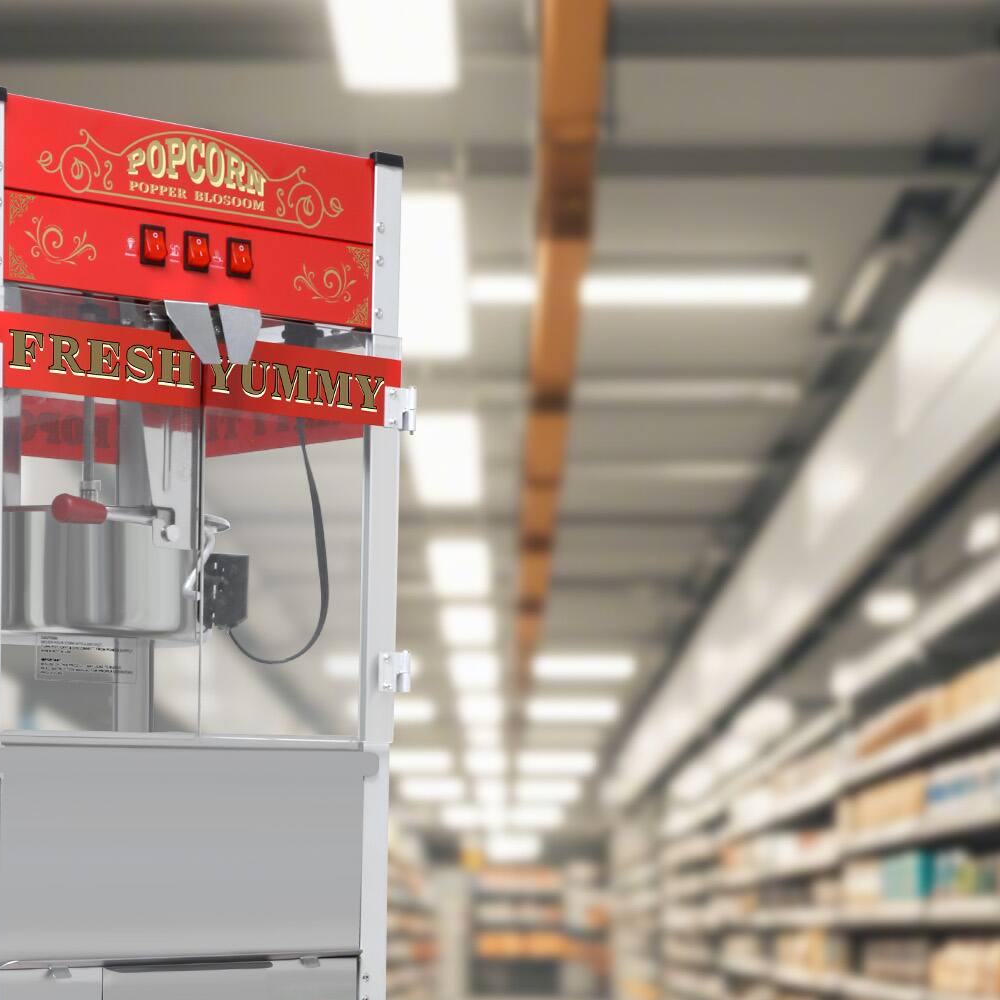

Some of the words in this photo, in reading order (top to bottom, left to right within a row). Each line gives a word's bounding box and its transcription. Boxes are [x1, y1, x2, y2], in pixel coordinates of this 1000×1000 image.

[127, 137, 266, 197] POPCORN
[129, 180, 187, 200] POPPER
[194, 190, 265, 212] BLOSOOM
[8, 329, 196, 389] FRESH
[205, 355, 385, 412] YUMMY
